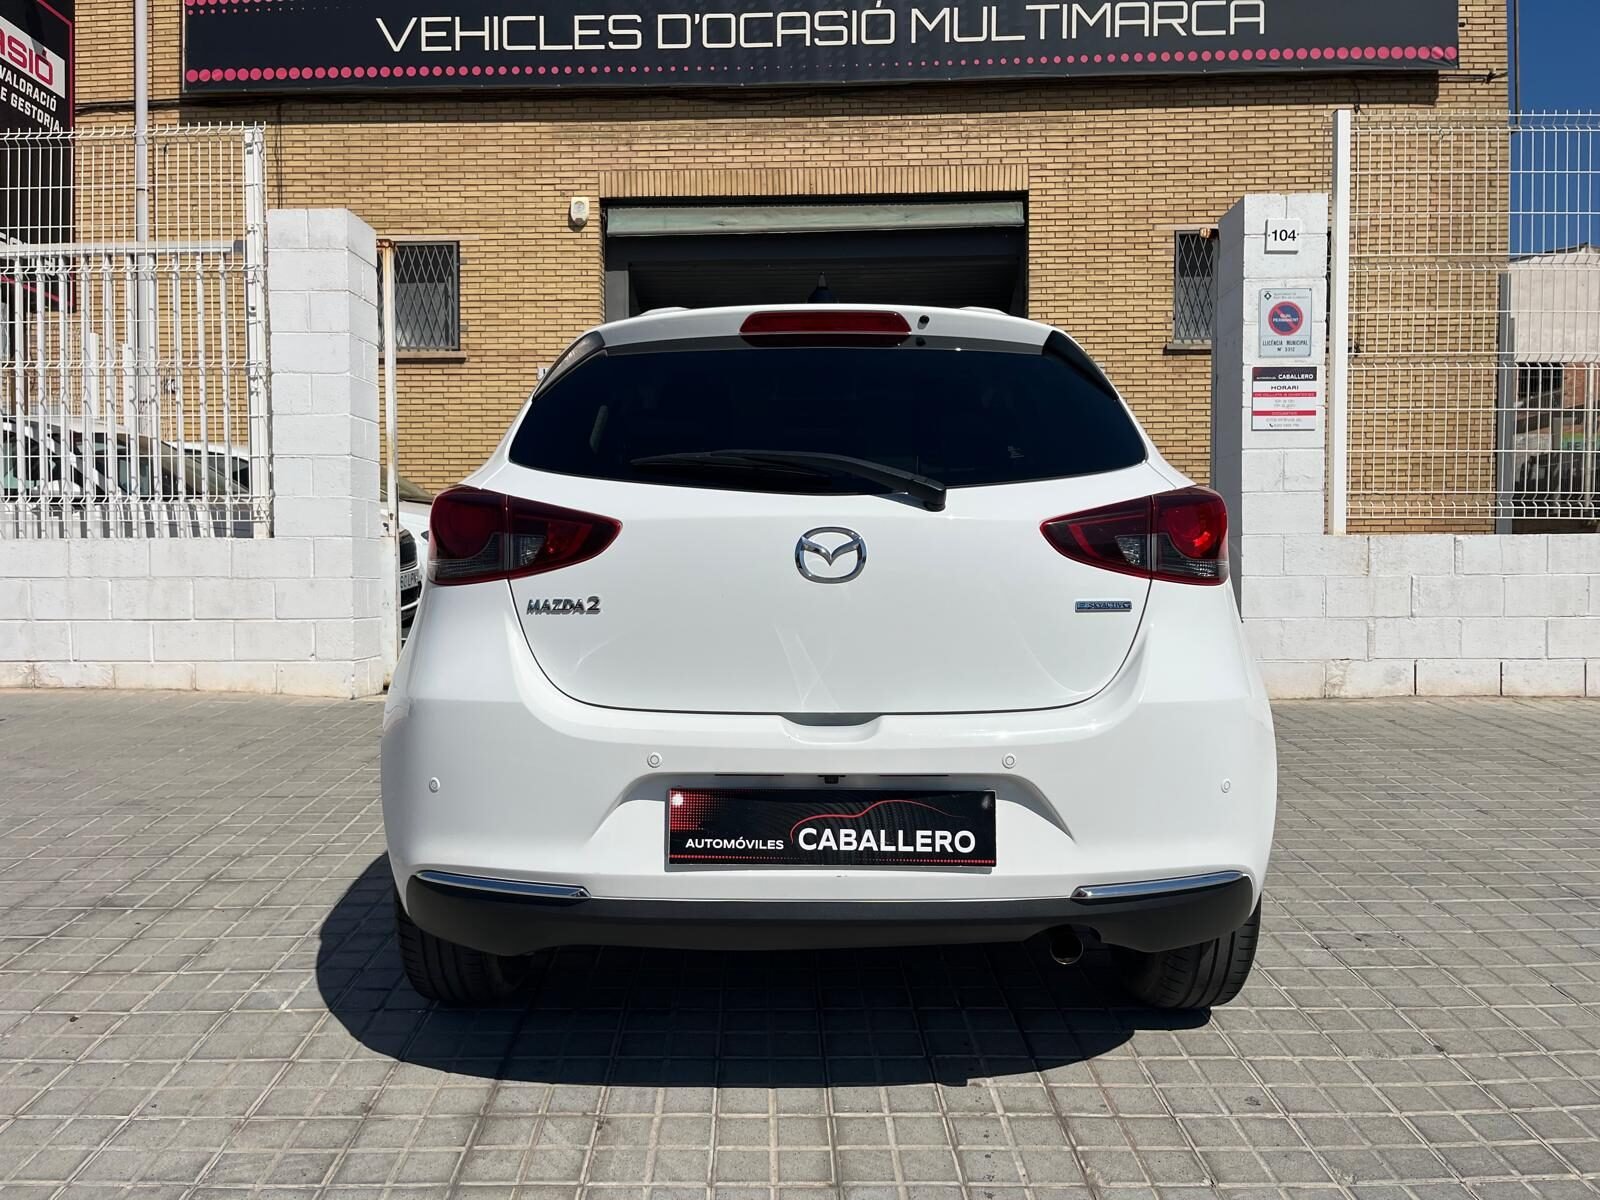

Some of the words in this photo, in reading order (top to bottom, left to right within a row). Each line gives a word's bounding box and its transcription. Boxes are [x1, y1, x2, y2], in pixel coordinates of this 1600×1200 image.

[375, 14, 643, 52] VEHICLES
[657, 0, 896, 50] D'OCASIÓ
[910, 0, 1266, 44] MULTIMARCA
[0, 28, 53, 86] SIÓ
[10, 92, 60, 133] GESTORIA
[1271, 229, 1297, 241] 104
[685, 836, 784, 850] AUTOMÓVILES
[797, 827, 976, 854] CABALLERO
